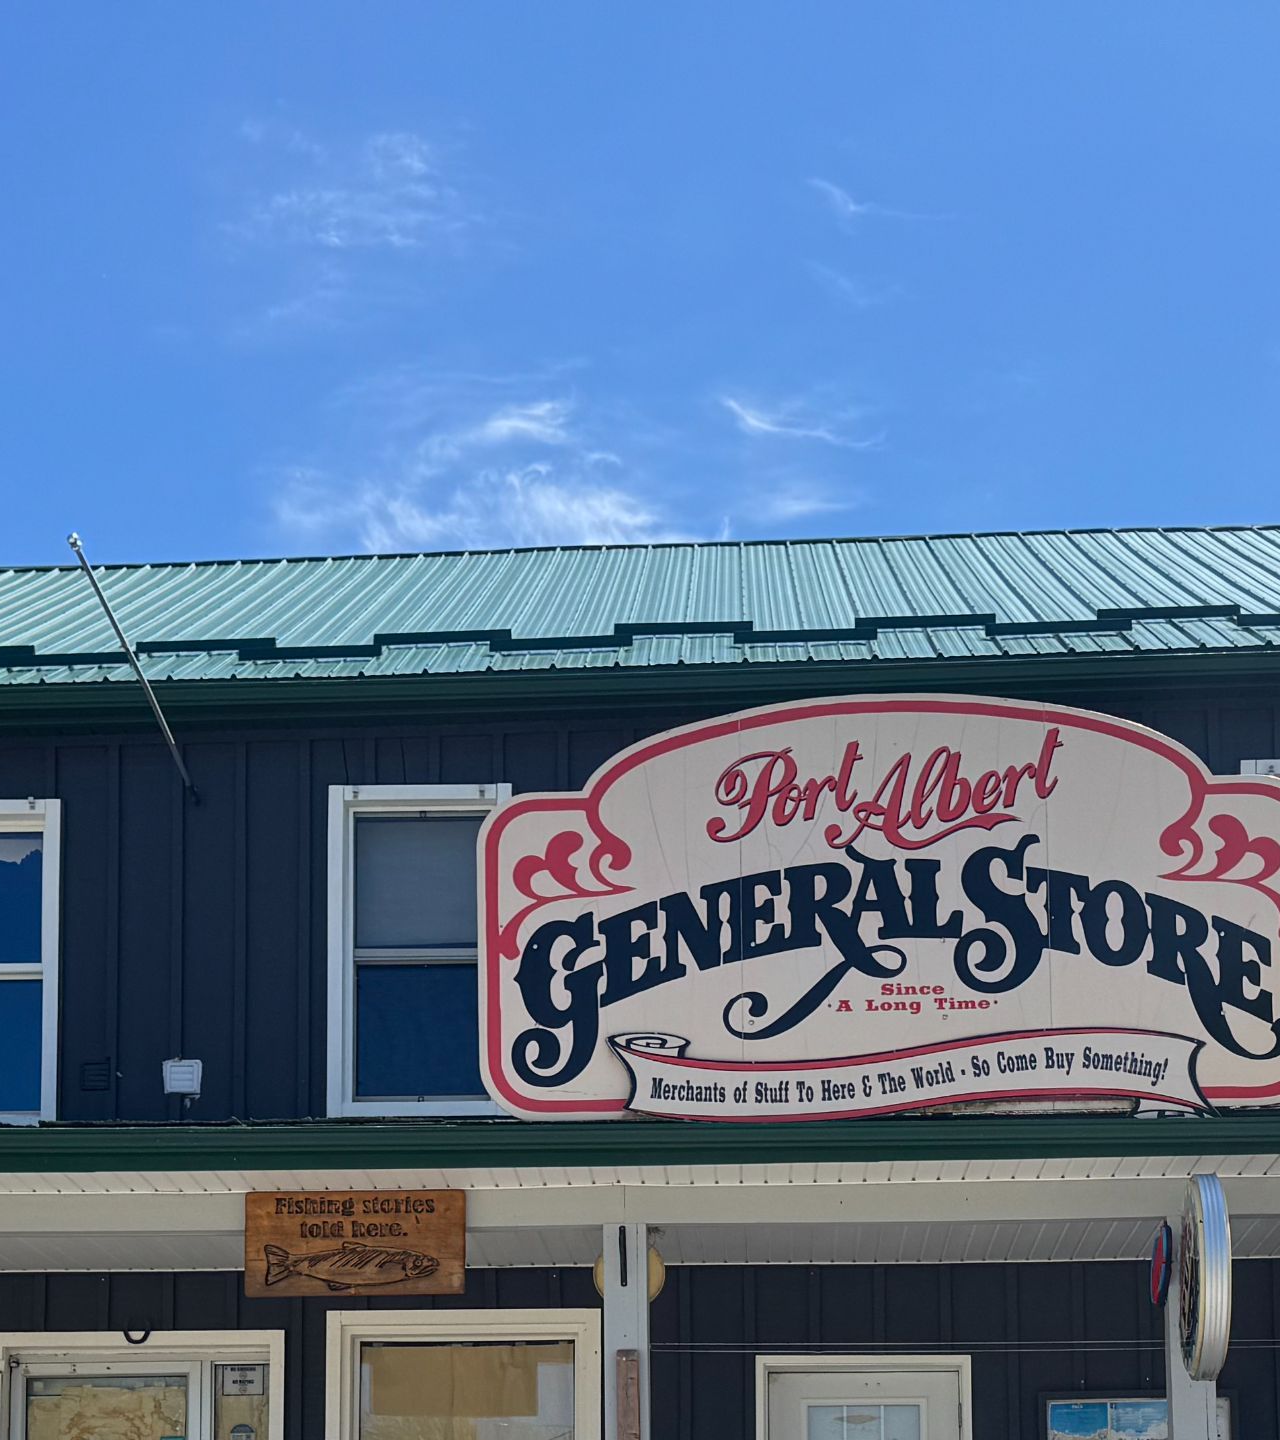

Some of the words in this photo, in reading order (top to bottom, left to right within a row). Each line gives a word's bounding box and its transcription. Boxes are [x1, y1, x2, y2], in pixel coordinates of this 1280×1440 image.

[706, 740, 863, 842] Port
[824, 727, 1064, 850] Albert
[512, 844, 965, 1088] GENERAL
[880, 983, 945, 996] Since
[865, 999, 921, 1014] Long
[934, 997, 990, 1011] Time
[651, 1077, 726, 1103] Merchants
[734, 1080, 748, 1104] of
[754, 1080, 789, 1104] Stuff
[796, 1081, 814, 1103] To
[821, 1079, 856, 1101] Here
[878, 1072, 906, 1096] The
[912, 1067, 955, 1094] World
[971, 1056, 991, 1078] So
[997, 1053, 1037, 1076] Come
[1043, 1047, 1074, 1076] Buy
[1082, 1046, 1168, 1086] Something!
[275, 1197, 355, 1216] Fishing
[362, 1196, 435, 1215] stories
[300, 1220, 344, 1238] told
[351, 1220, 408, 1238] here.
